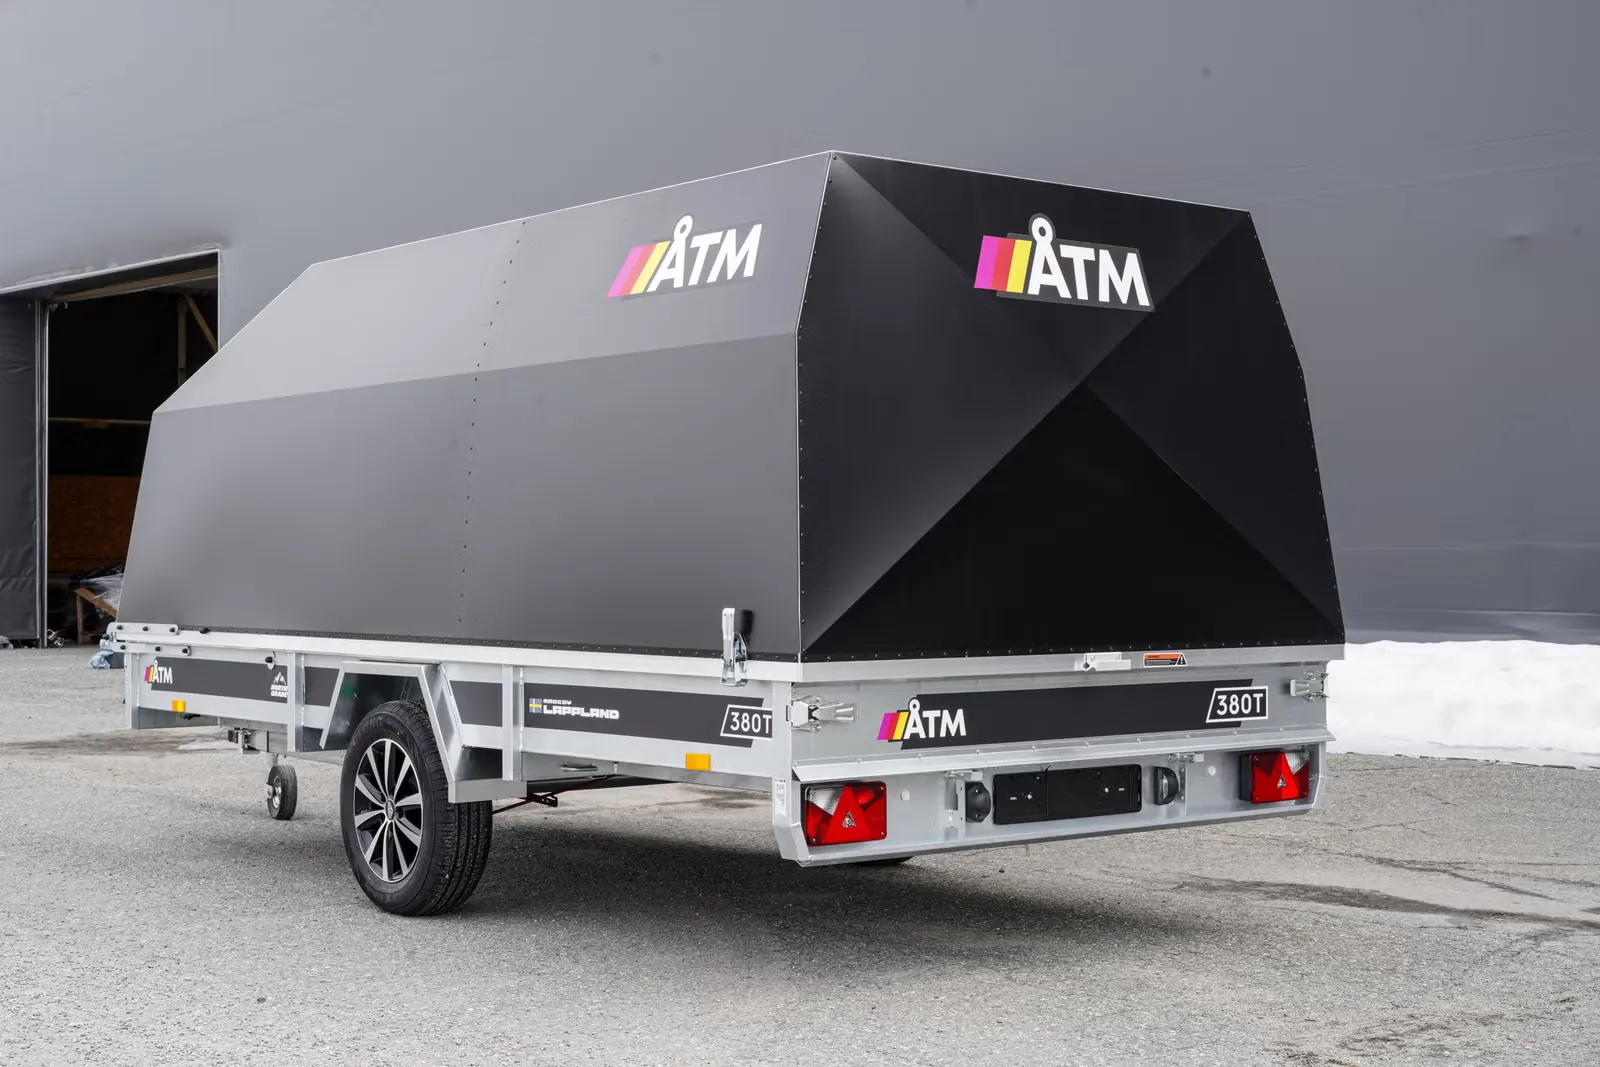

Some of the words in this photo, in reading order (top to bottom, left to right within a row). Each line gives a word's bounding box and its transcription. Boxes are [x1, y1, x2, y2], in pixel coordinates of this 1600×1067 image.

[646, 215, 763, 293] ÅTM
[1027, 217, 1150, 307] ÅTM
[152, 659, 173, 684] ÅTM
[543, 705, 620, 719] LAPPLAND
[1216, 693, 1264, 716] 380T
[730, 710, 773, 734] 380T
[903, 699, 967, 740] ÅTM
